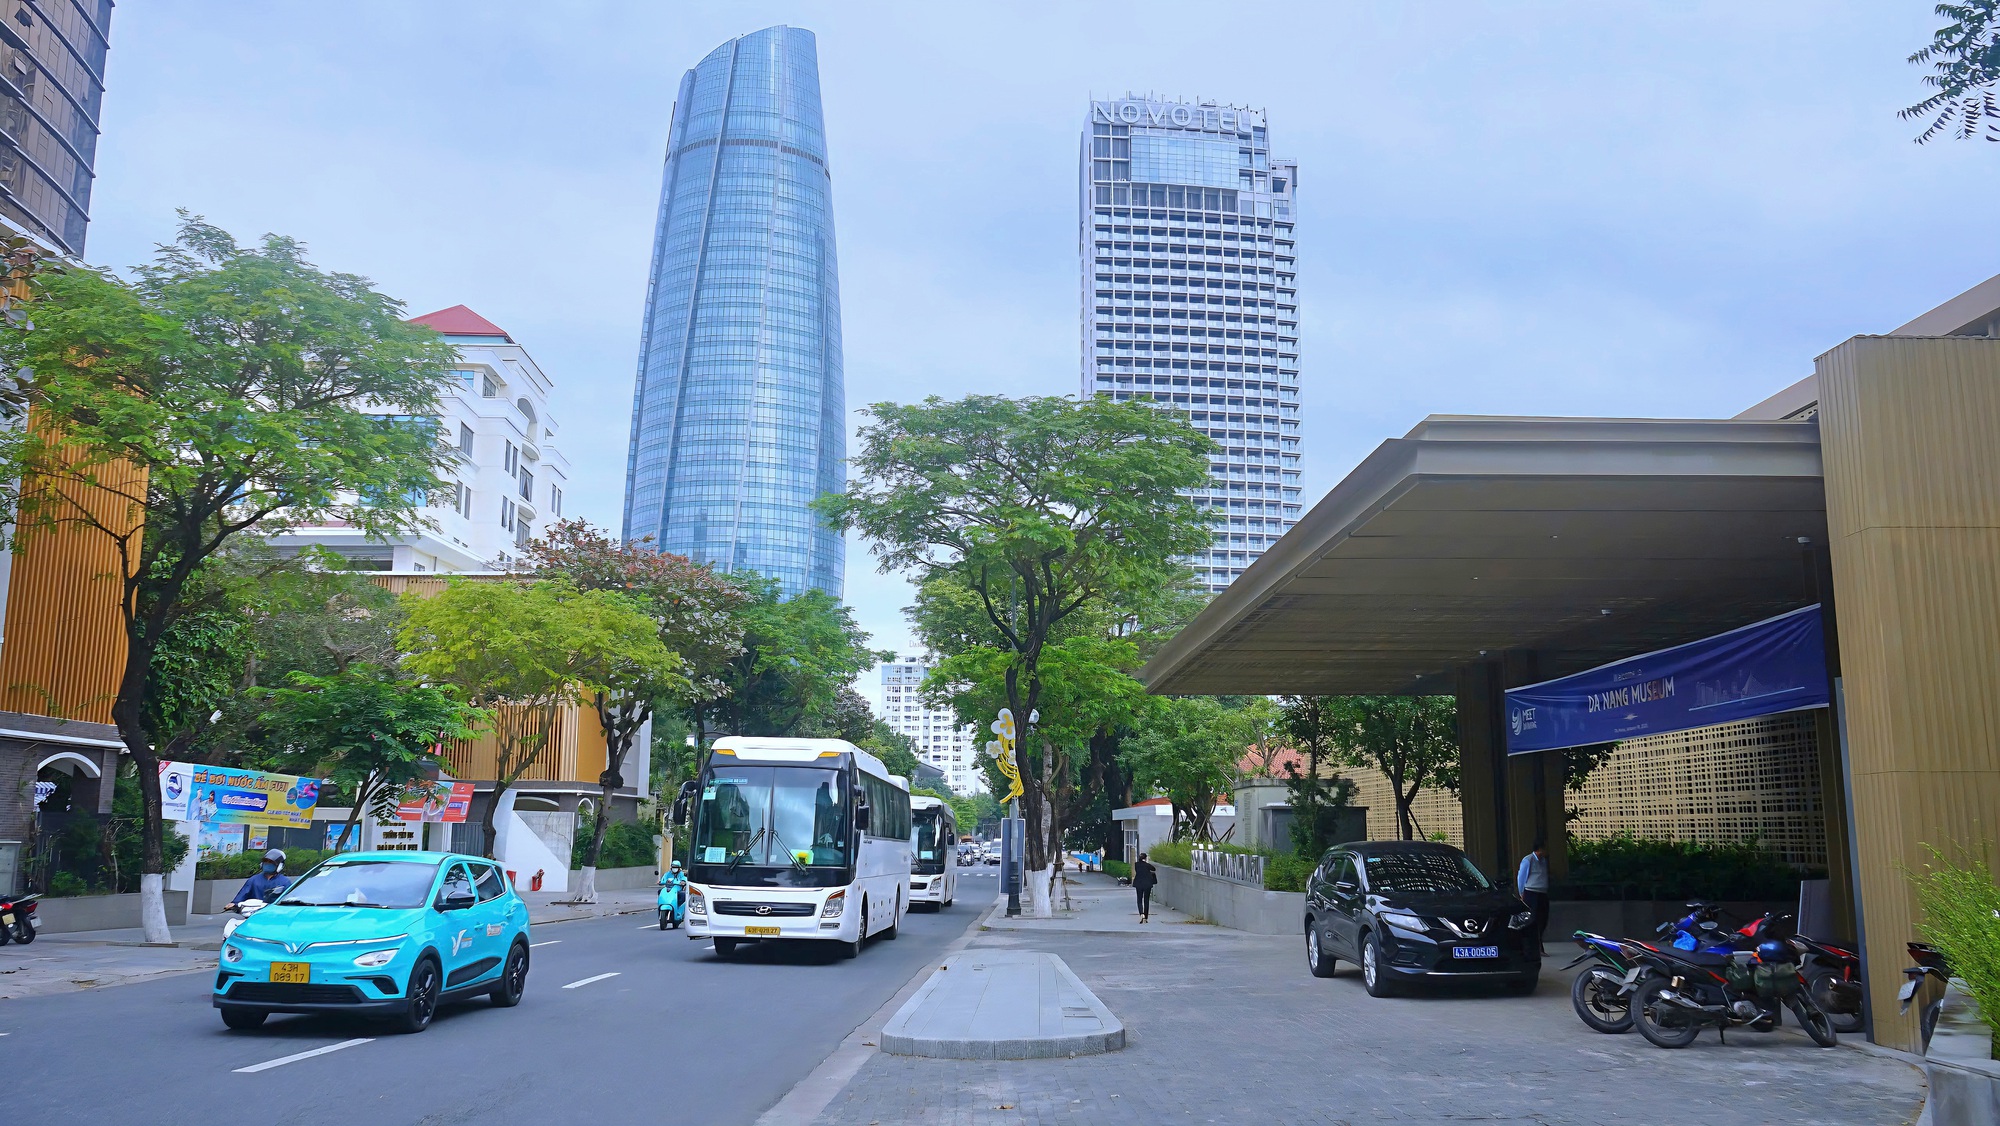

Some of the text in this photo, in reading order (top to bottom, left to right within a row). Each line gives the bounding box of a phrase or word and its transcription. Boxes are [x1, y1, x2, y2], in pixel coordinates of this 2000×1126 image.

[1092, 101, 1252, 134] NOVOTEL
[1587, 676, 1675, 713] DA NANG MUSEUM
[1522, 707, 1536, 721] MEET
